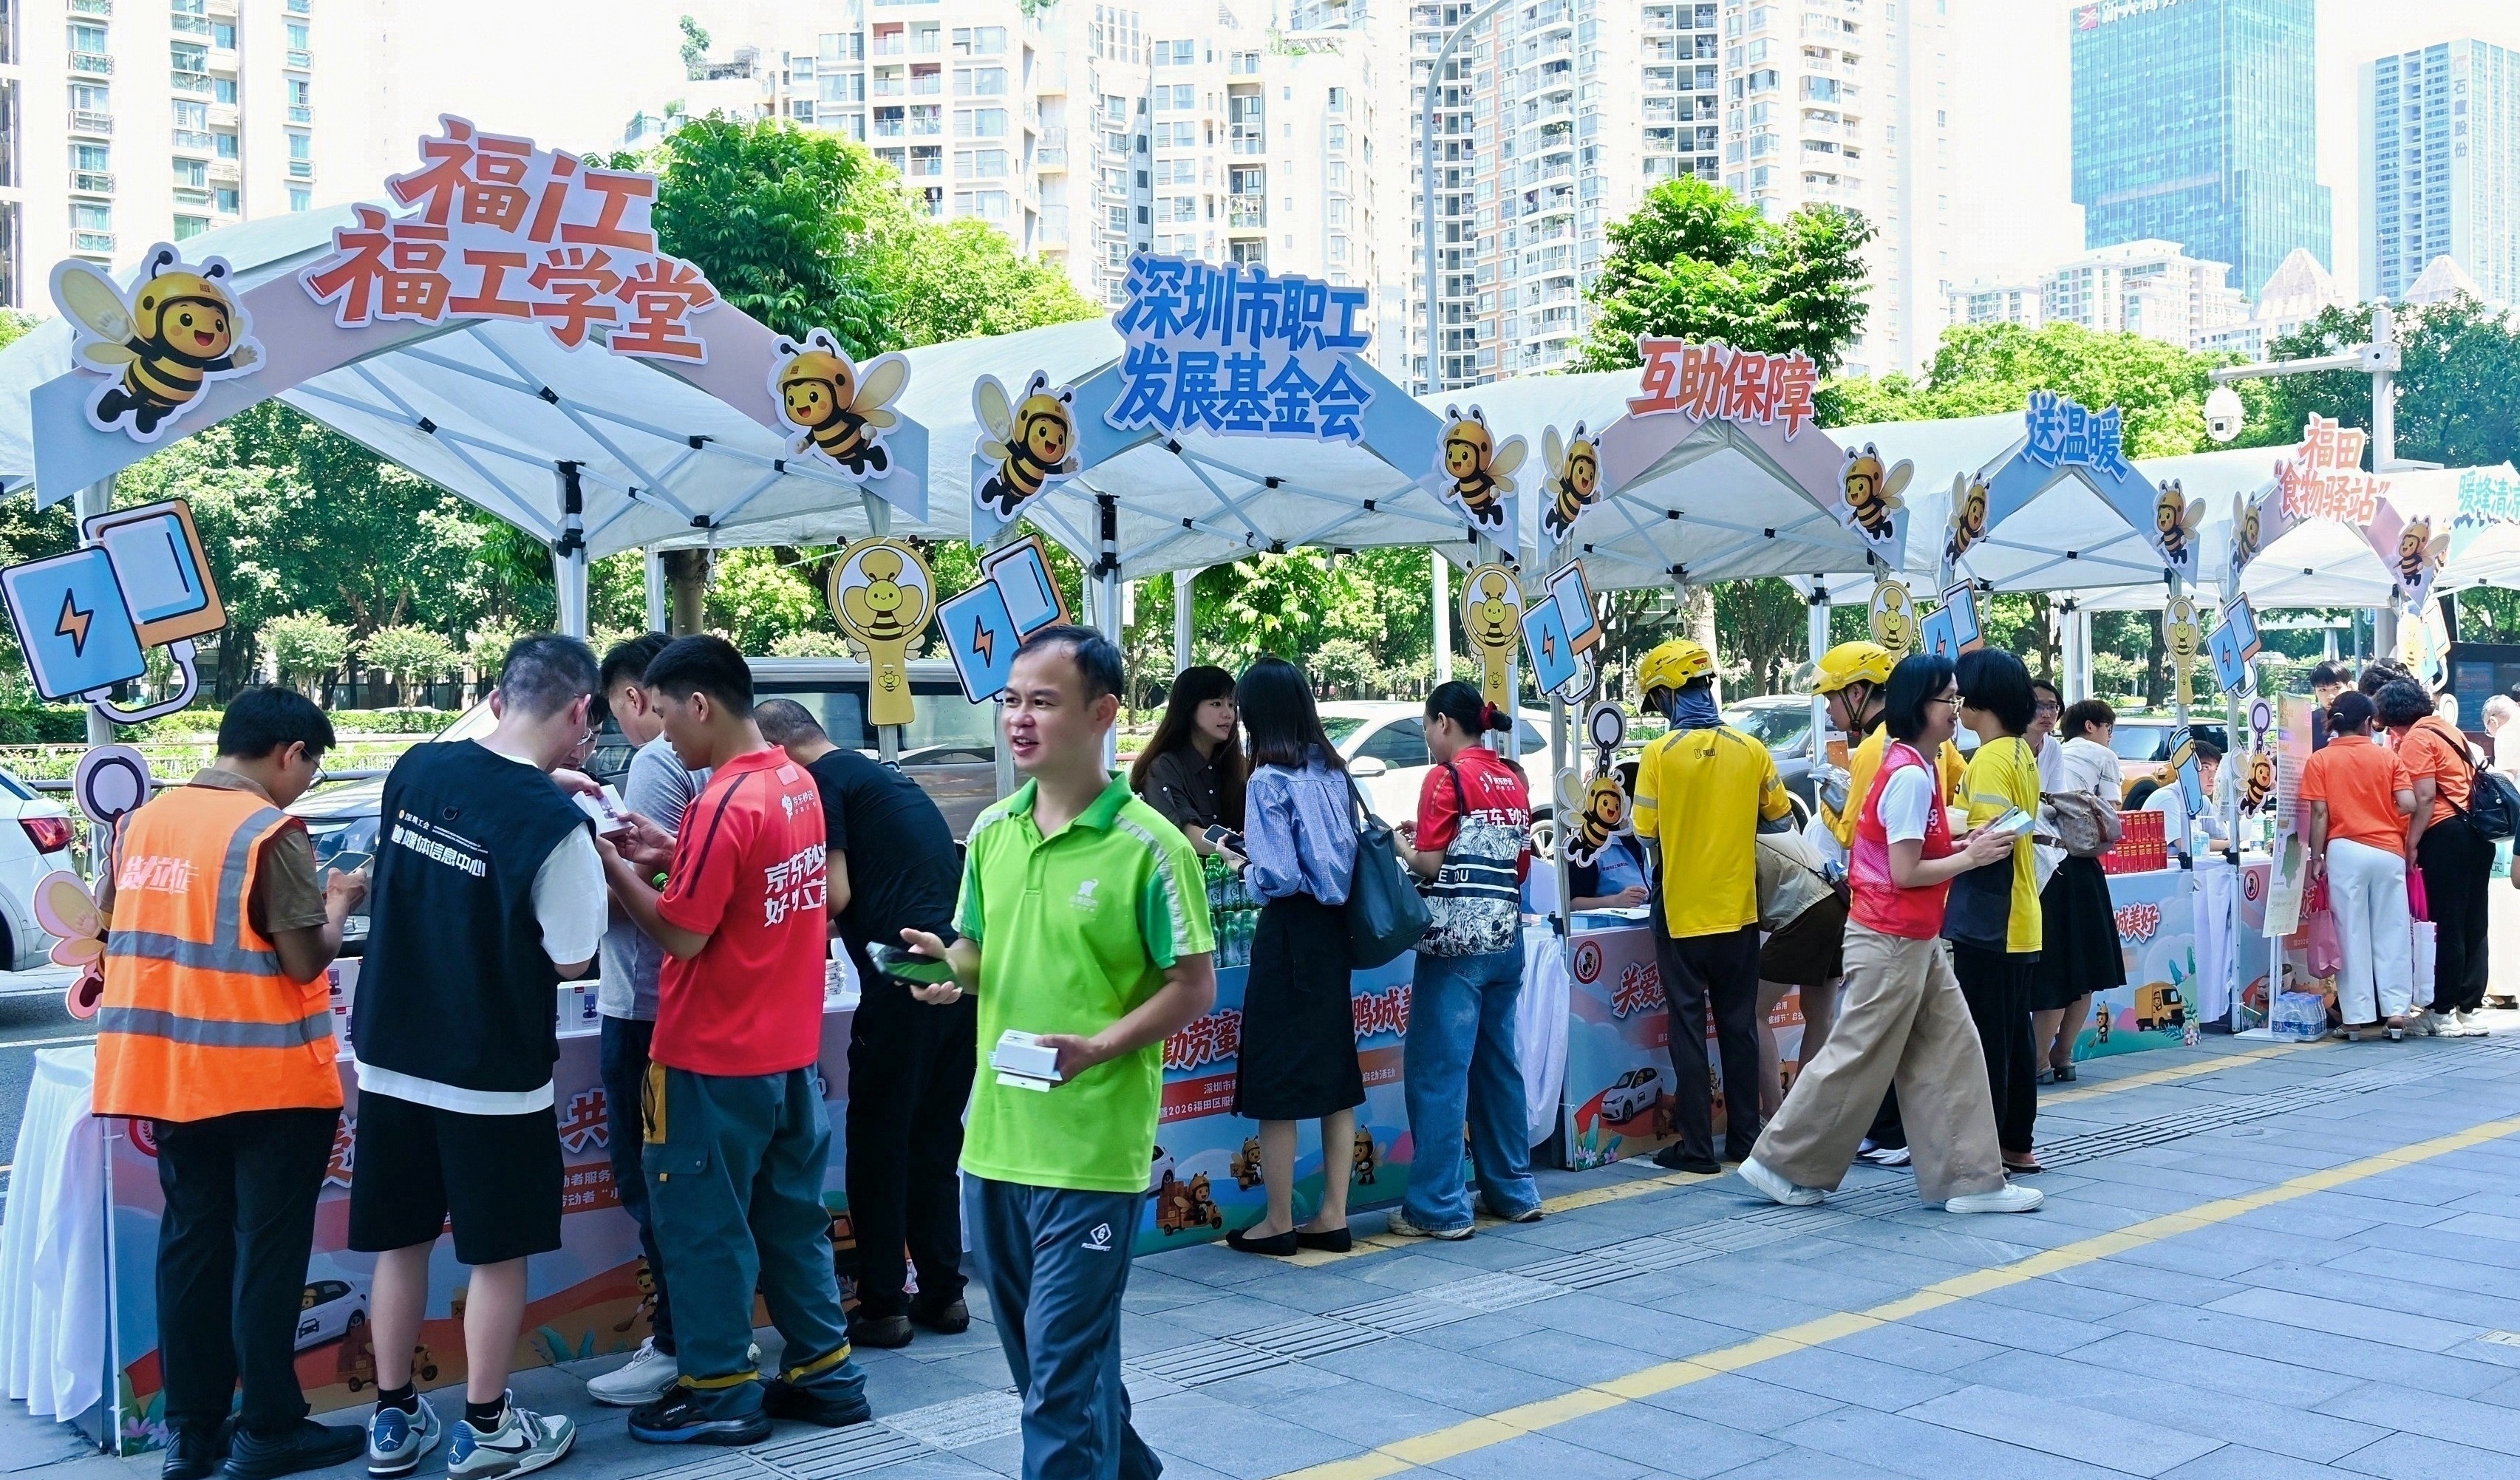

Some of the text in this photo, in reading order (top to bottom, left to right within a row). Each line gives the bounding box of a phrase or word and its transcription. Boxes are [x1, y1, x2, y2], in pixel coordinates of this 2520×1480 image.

[307, 210, 715, 357] 福工学堂
[1117, 256, 1369, 351] 深圳市职工
[1111, 341, 1370, 441] 发展基金会
[1630, 338, 1816, 440] 互助保障
[2023, 394, 2126, 479] 送温暖
[2299, 416, 2363, 470] 福田
[404, 813, 429, 830] 深圳工会
[793, 790, 814, 807] 京东秒送
[764, 841, 826, 895] 京东秒
[1613, 964, 1665, 1015] 关爱
[1773, 1001, 1787, 1011] 启用
[1363, 1068, 1395, 1082] 启动活动
[559, 1092, 608, 1148] 共
